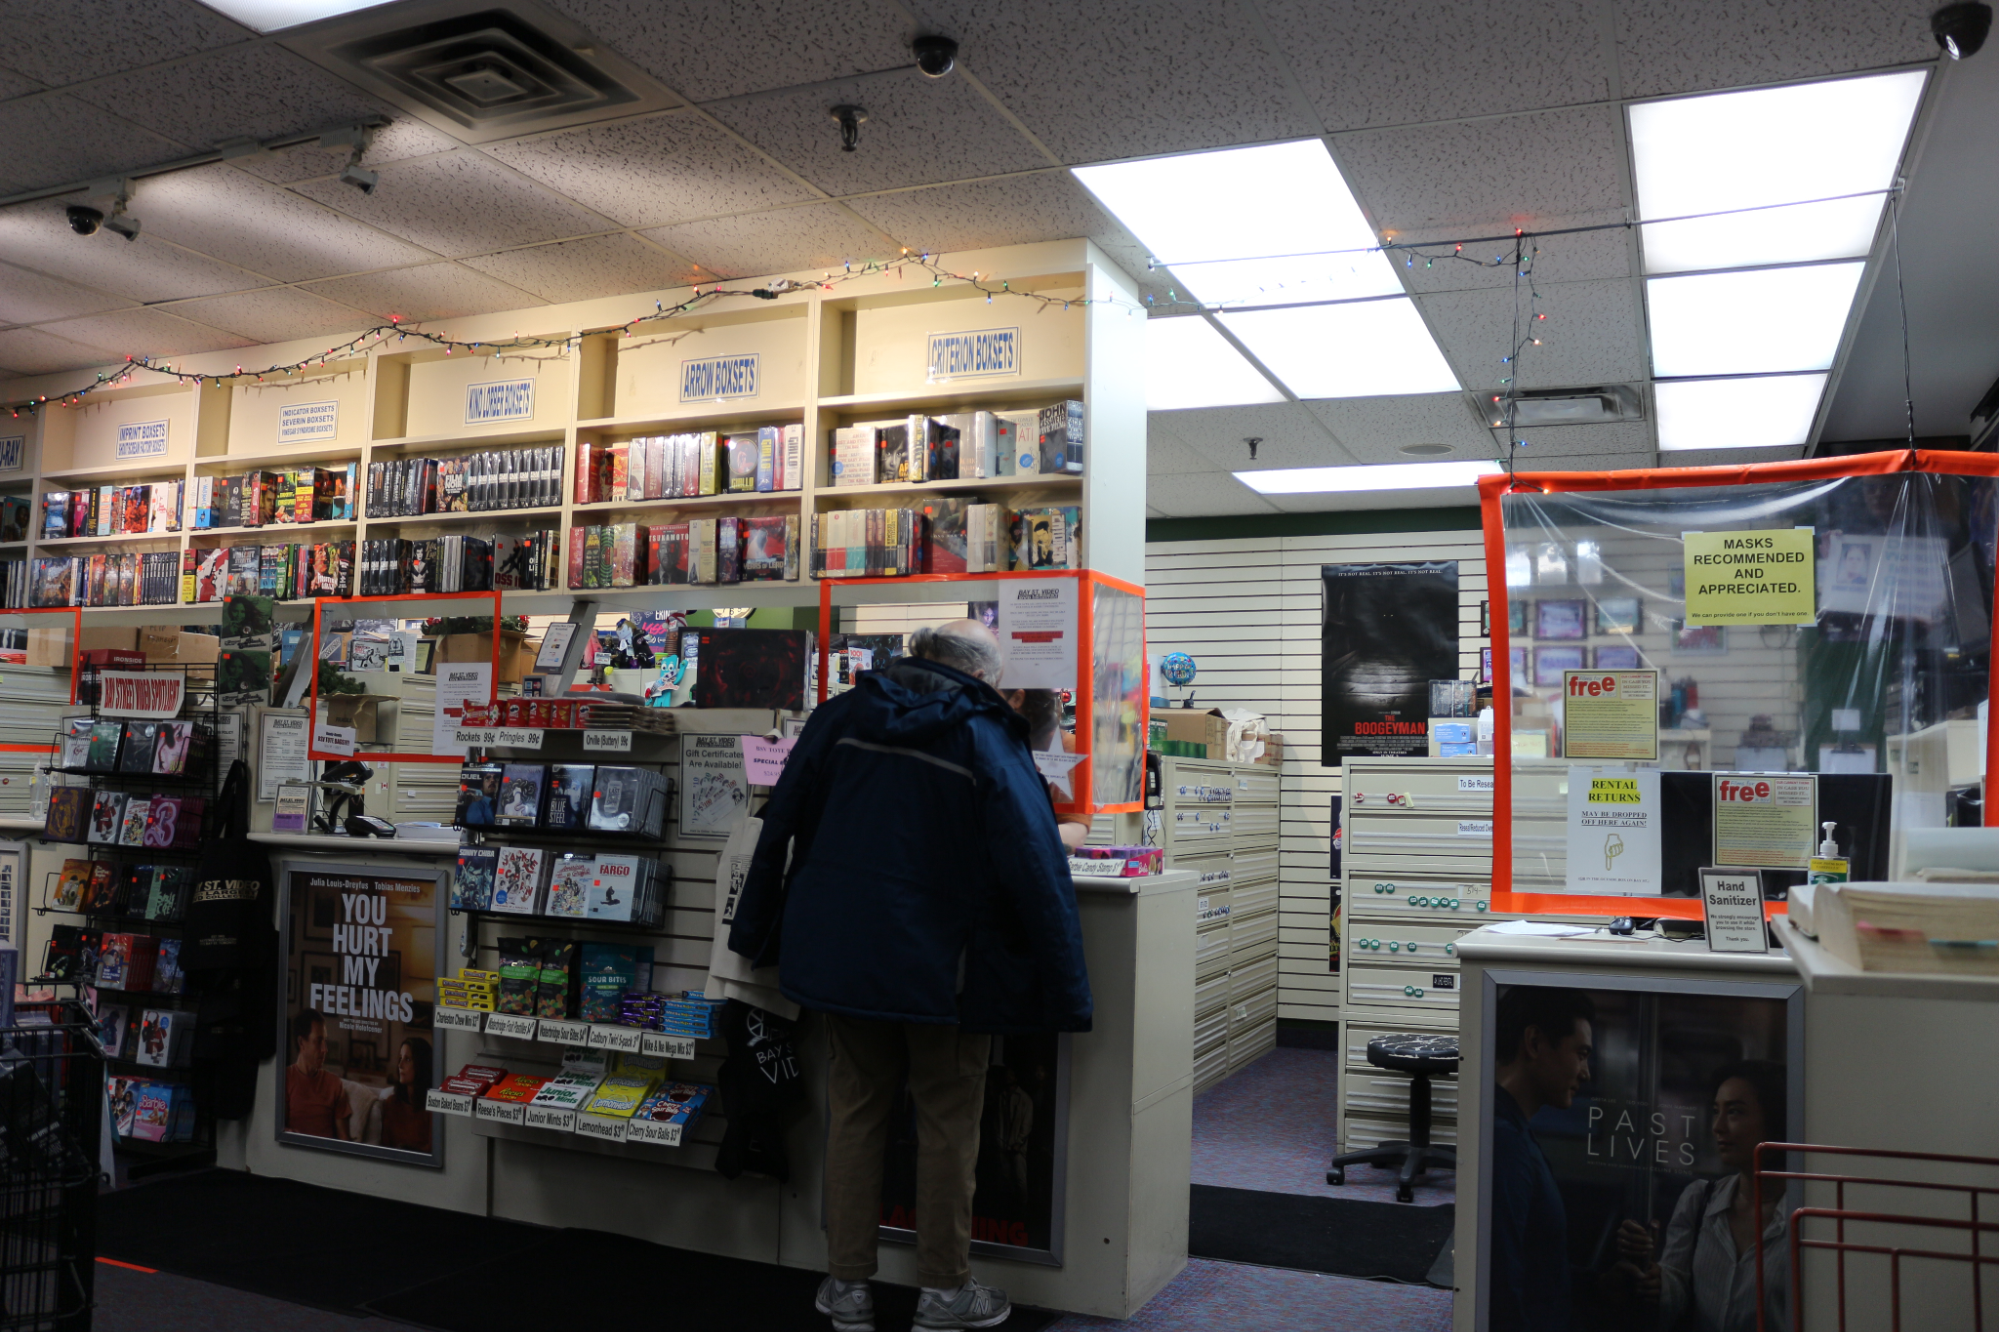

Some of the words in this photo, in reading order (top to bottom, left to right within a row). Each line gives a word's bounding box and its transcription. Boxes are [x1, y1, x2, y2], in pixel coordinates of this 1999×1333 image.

[932, 336, 974, 375] CRITERION
[976, 332, 1013, 371] BOXSETS
[684, 362, 714, 397] ARROW
[716, 359, 755, 394] BOXSETS
[505, 382, 530, 415] BOXSETS
[283, 408, 309, 417] INDICATOR
[310, 405, 334, 414] BOXSETS
[282, 417, 305, 426] SEVERIN
[307, 415, 334, 423] BOXSETS
[120, 427, 141, 441] IMPRINT
[142, 423, 165, 439] BOXSETS
[446, 474, 462, 482] FILM
[649, 534, 688, 542] TSUKAMOTO
[1724, 538, 1773, 549] MASKS
[1694, 552, 1805, 564] RECOMMENDED
[495, 572, 512, 586] OSS
[1734, 569, 1764, 579] AND
[1699, 583, 1801, 594] APPRECIATED.
[1569, 676, 1616, 696] free
[116, 678, 134, 710] STREET
[134, 678, 150, 711] VIDEO
[151, 678, 180, 712] SPOTLIGHT
[1354, 722, 1426, 734] BOOGEYMAN
[456, 732, 480, 742] Rockets
[484, 733, 495, 743] 99¢
[500, 732, 524, 744] Pringles
[528, 733, 540, 745] 99¢
[586, 735, 600, 745] Orville
[601, 735, 620, 748] (Buttery)
[620, 736, 629, 746] 99¢
[686, 749, 699, 758] Gift
[702, 750, 744, 759] Certificates
[1460, 780, 1466, 788] To
[1468, 780, 1475, 788] Be
[1592, 780, 1637, 790] RENTAL
[1588, 793, 1641, 802] RETURNS
[1720, 781, 1770, 802] free
[550, 801, 566, 812] BLUE
[549, 812, 566, 824] STEEL
[600, 864, 630, 876] FARGO
[1082, 862, 1098, 874] Candy
[204, 880, 221, 890] ST.
[225, 880, 260, 891] VIDEO
[310, 878, 325, 887] Julia
[327, 879, 369, 890] Louis-Dreyfus
[375, 882, 394, 891] Tobias
[395, 883, 421, 893] Menzies
[1717, 881, 1745, 891] Hand
[1709, 895, 1756, 906] Sanitizer
[342, 893, 387, 926] YOU
[333, 923, 393, 957] HURT
[344, 955, 380, 987] MY
[310, 983, 414, 1023] FEELINGS
[436, 1012, 454, 1024] Charleston
[455, 1014, 464, 1025] Chew
[488, 1018, 506, 1034] Waterbridge
[540, 1025, 560, 1042] Waterbridge
[560, 1027, 570, 1038] Sour
[570, 1027, 579, 1041] Bites
[590, 1031, 608, 1047] Cadbury
[608, 1033, 618, 1045] Twirl
[619, 1035, 632, 1048] 5-pack
[644, 1039, 653, 1051] Mike
[654, 1040, 658, 1051] &
[665, 1043, 676, 1056] Mega
[756, 1044, 782, 1064] BAY
[559, 1071, 596, 1080] Junior
[607, 1078, 648, 1087] Lemonhead
[540, 1087, 576, 1097] Junior
[139, 1094, 167, 1110] Barbie
[428, 1096, 440, 1108] Boston
[441, 1098, 452, 1110] Baked
[453, 1100, 464, 1111] Beans
[593, 1099, 635, 1110] Lemonhead
[478, 1104, 496, 1117] Reese's
[496, 1106, 512, 1119] Pieces
[528, 1111, 546, 1123] Junior
[547, 1114, 562, 1126] Mints
[1589, 1106, 1695, 1138] PAST
[579, 1119, 612, 1136] Lemonhead
[629, 1124, 644, 1139] Cherry
[645, 1126, 658, 1138] Sour
[658, 1127, 670, 1140] Balls
[1587, 1133, 1694, 1166] LIVES
